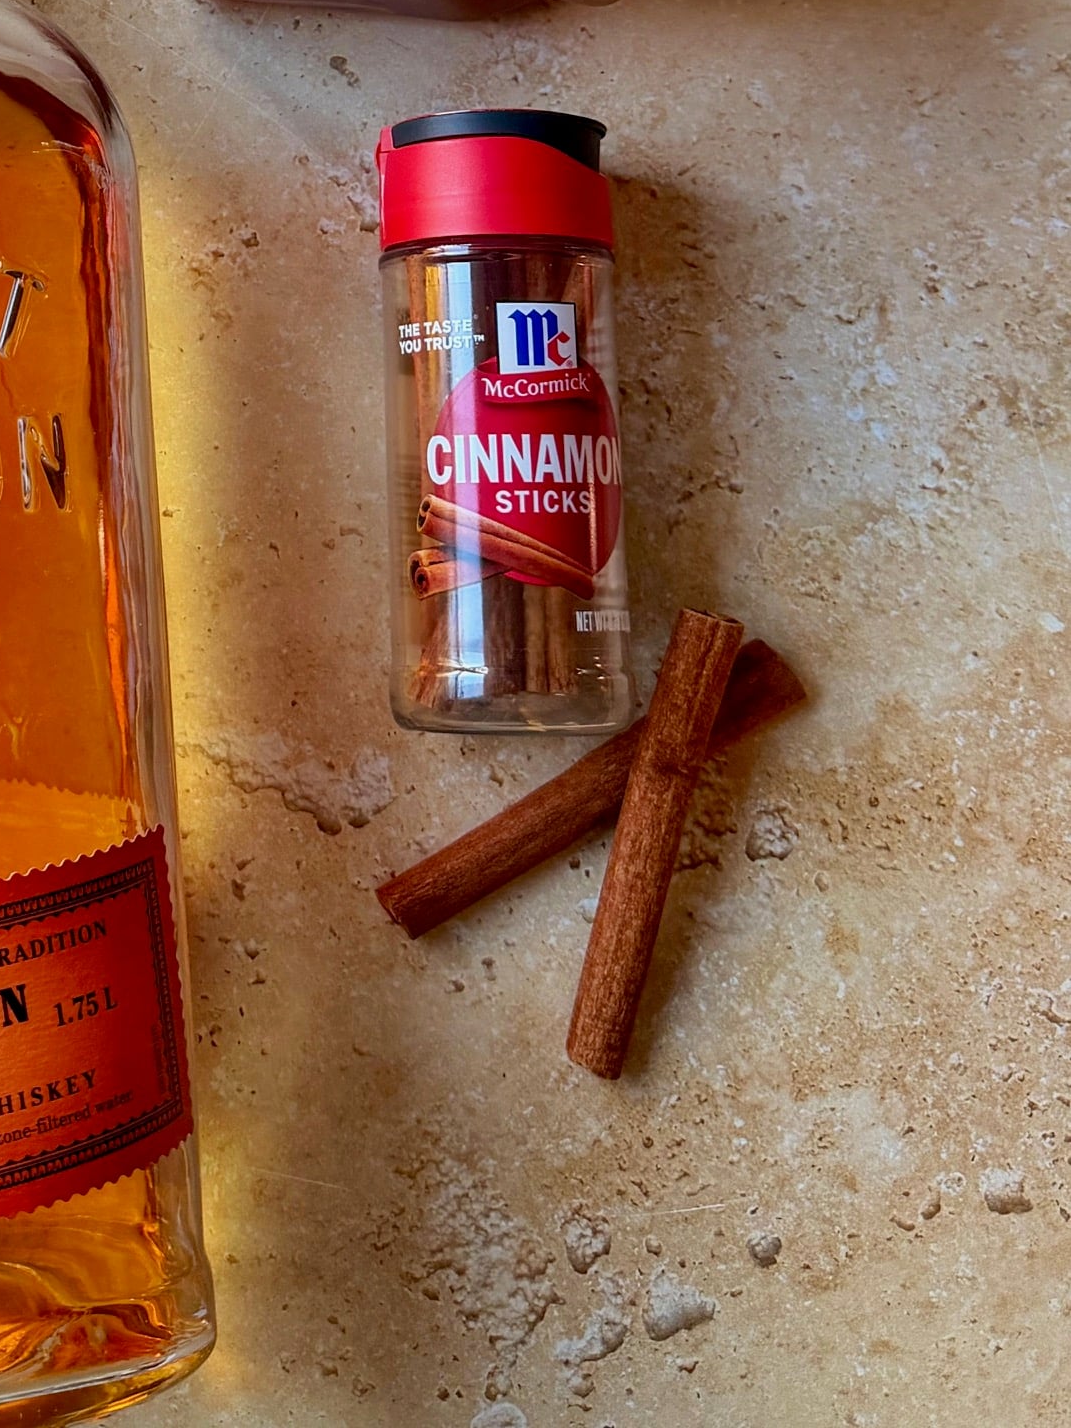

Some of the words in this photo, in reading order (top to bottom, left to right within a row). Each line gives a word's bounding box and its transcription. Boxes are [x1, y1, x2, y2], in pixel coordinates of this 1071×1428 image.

[398, 323, 421, 339] THE
[423, 319, 473, 335] TASTE
[399, 339, 422, 355] YOU
[480, 373, 589, 398] McCormick
[495, 489, 591, 514] STICKS
[54, 992, 99, 1028] 1.75
[104, 987, 118, 1010] L
